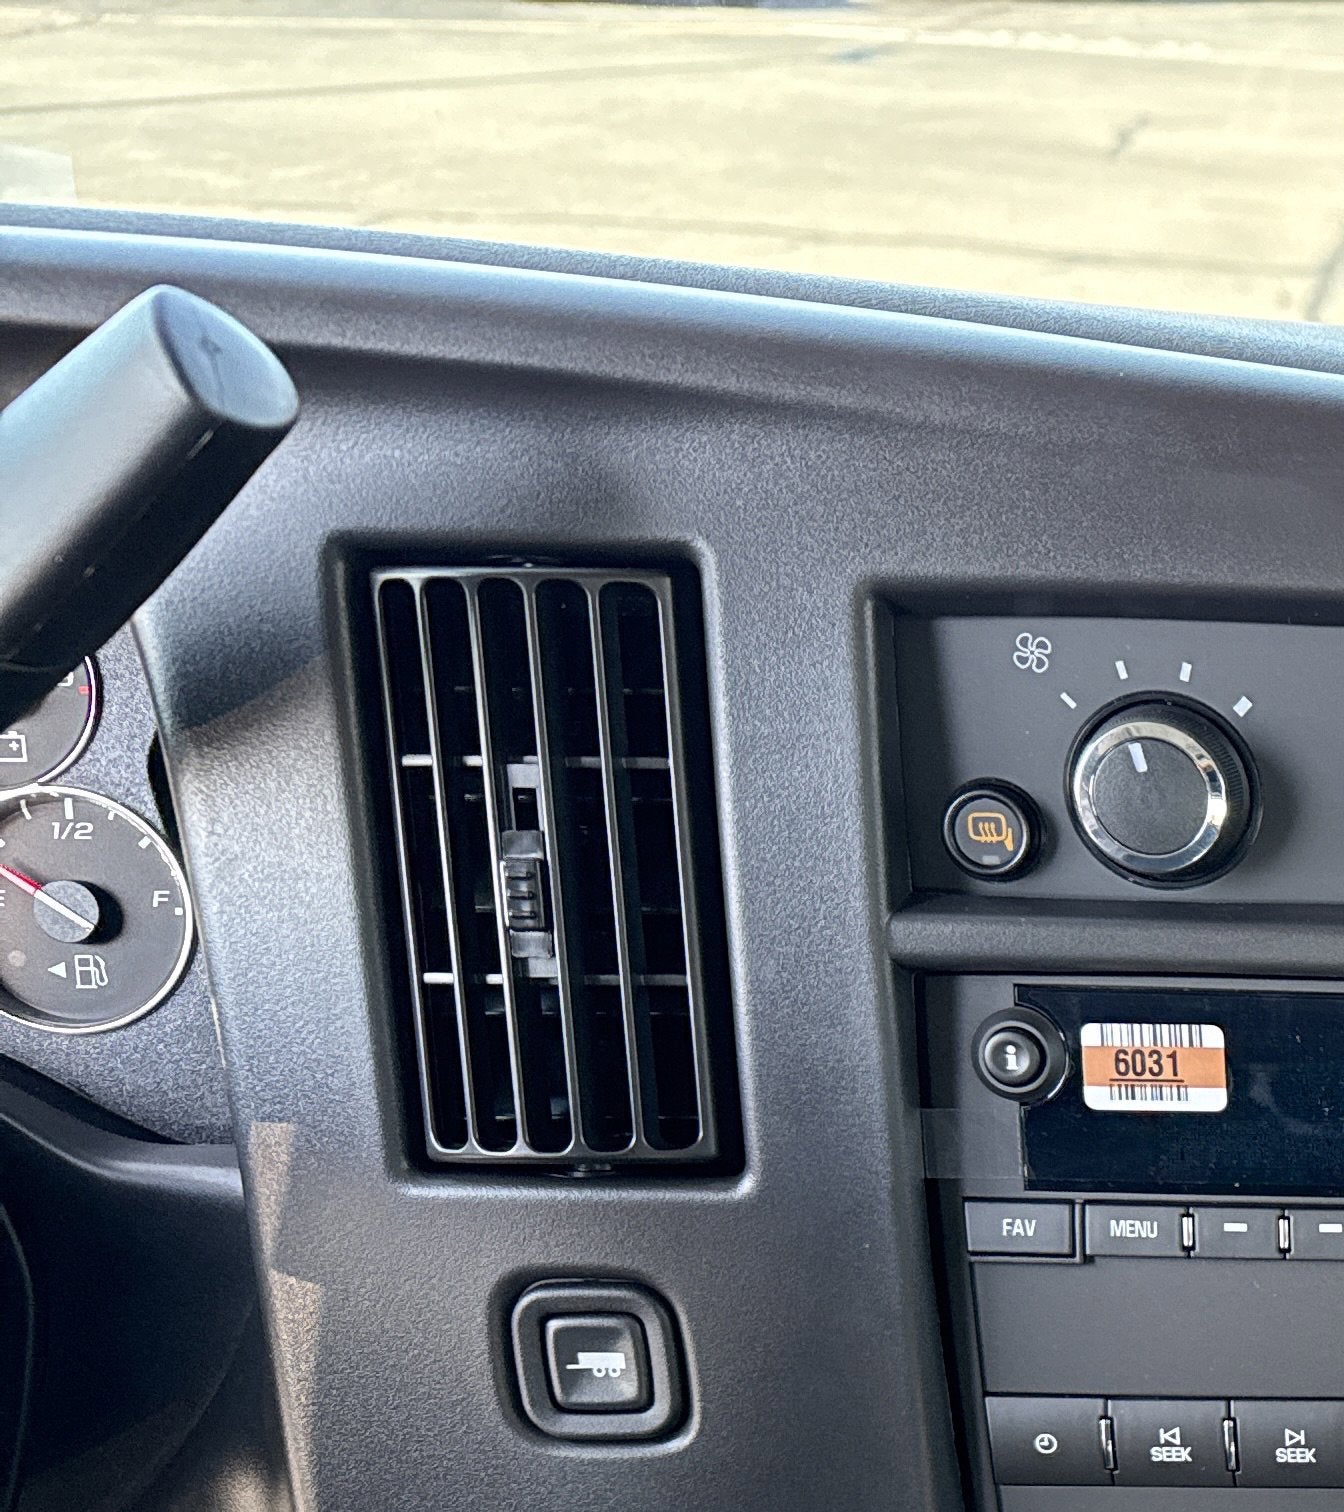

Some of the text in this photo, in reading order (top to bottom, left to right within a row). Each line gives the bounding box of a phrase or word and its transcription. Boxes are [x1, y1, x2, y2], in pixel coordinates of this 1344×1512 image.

[51, 821, 94, 840] 1/2
[152, 890, 171, 908] F
[1113, 1048, 1180, 1077] 6031
[1002, 1218, 1037, 1237] FAV
[1109, 1219, 1158, 1239] MENU
[1150, 1446, 1193, 1462] SEEK
[1275, 1446, 1317, 1463] SEEK
